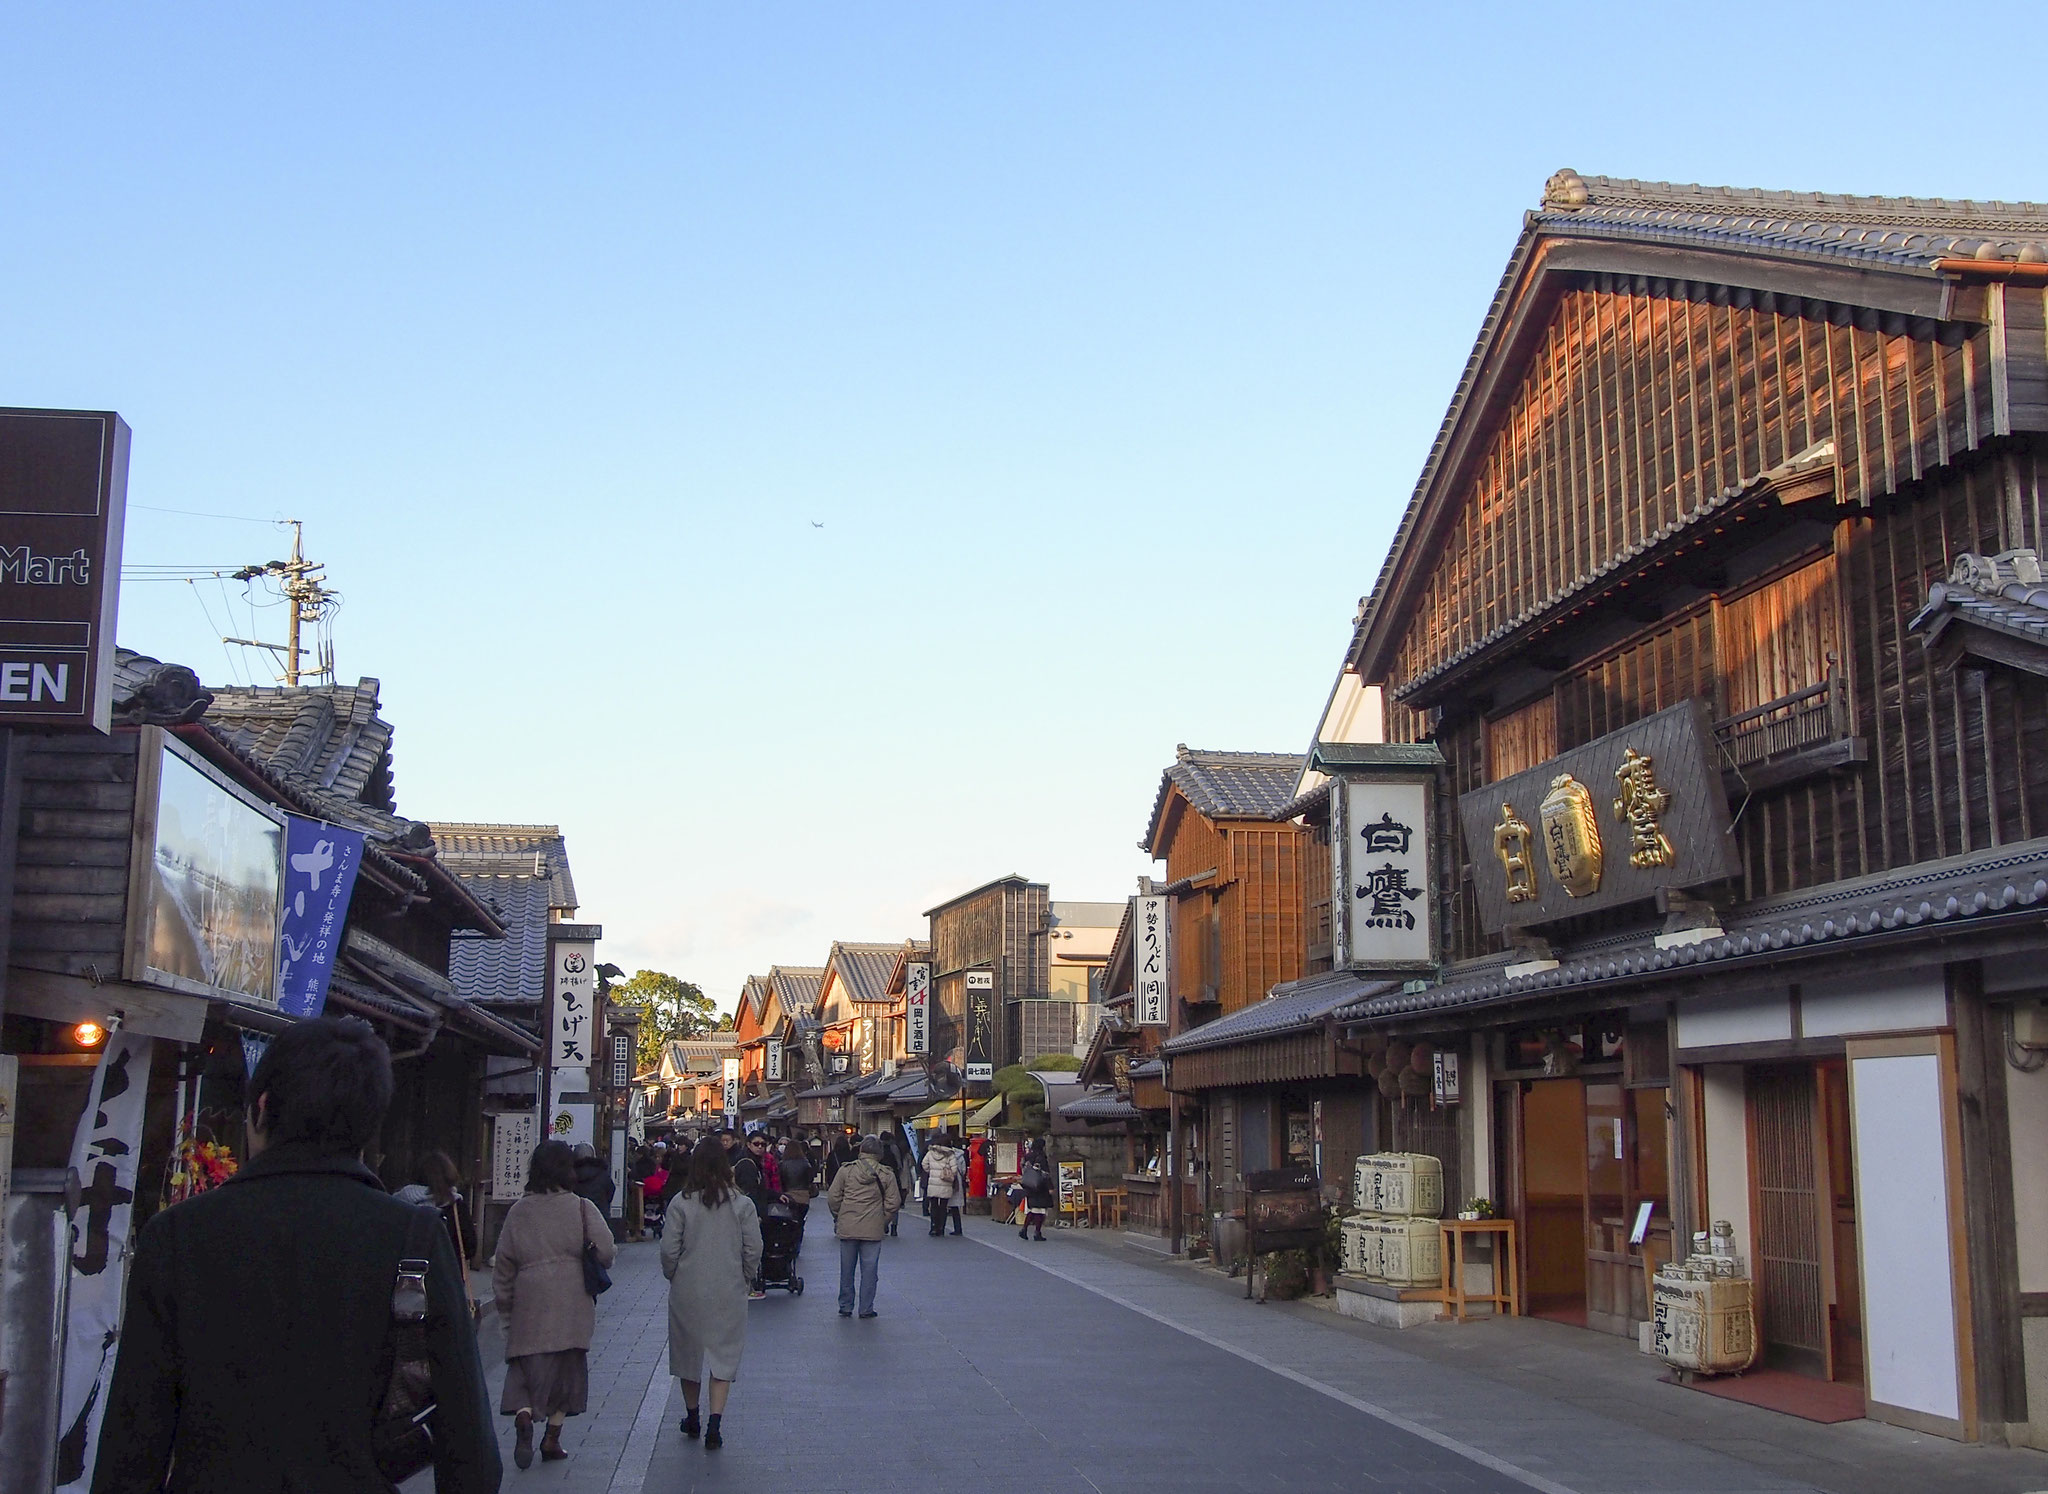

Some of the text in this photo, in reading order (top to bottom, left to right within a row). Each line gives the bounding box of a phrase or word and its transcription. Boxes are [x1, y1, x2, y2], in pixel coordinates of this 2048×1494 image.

[0, 546, 90, 586] Mart
[0, 662, 69, 702] EN
[1355, 812, 1426, 931] 白鷹
[1493, 802, 1537, 903] 白
[311, 845, 351, 965] さんま寿し発祥の地
[561, 991, 588, 1062] ひげ天
[1146, 980, 1160, 1022] 岡田屋
[862, 1019, 873, 1061] ラーメン
